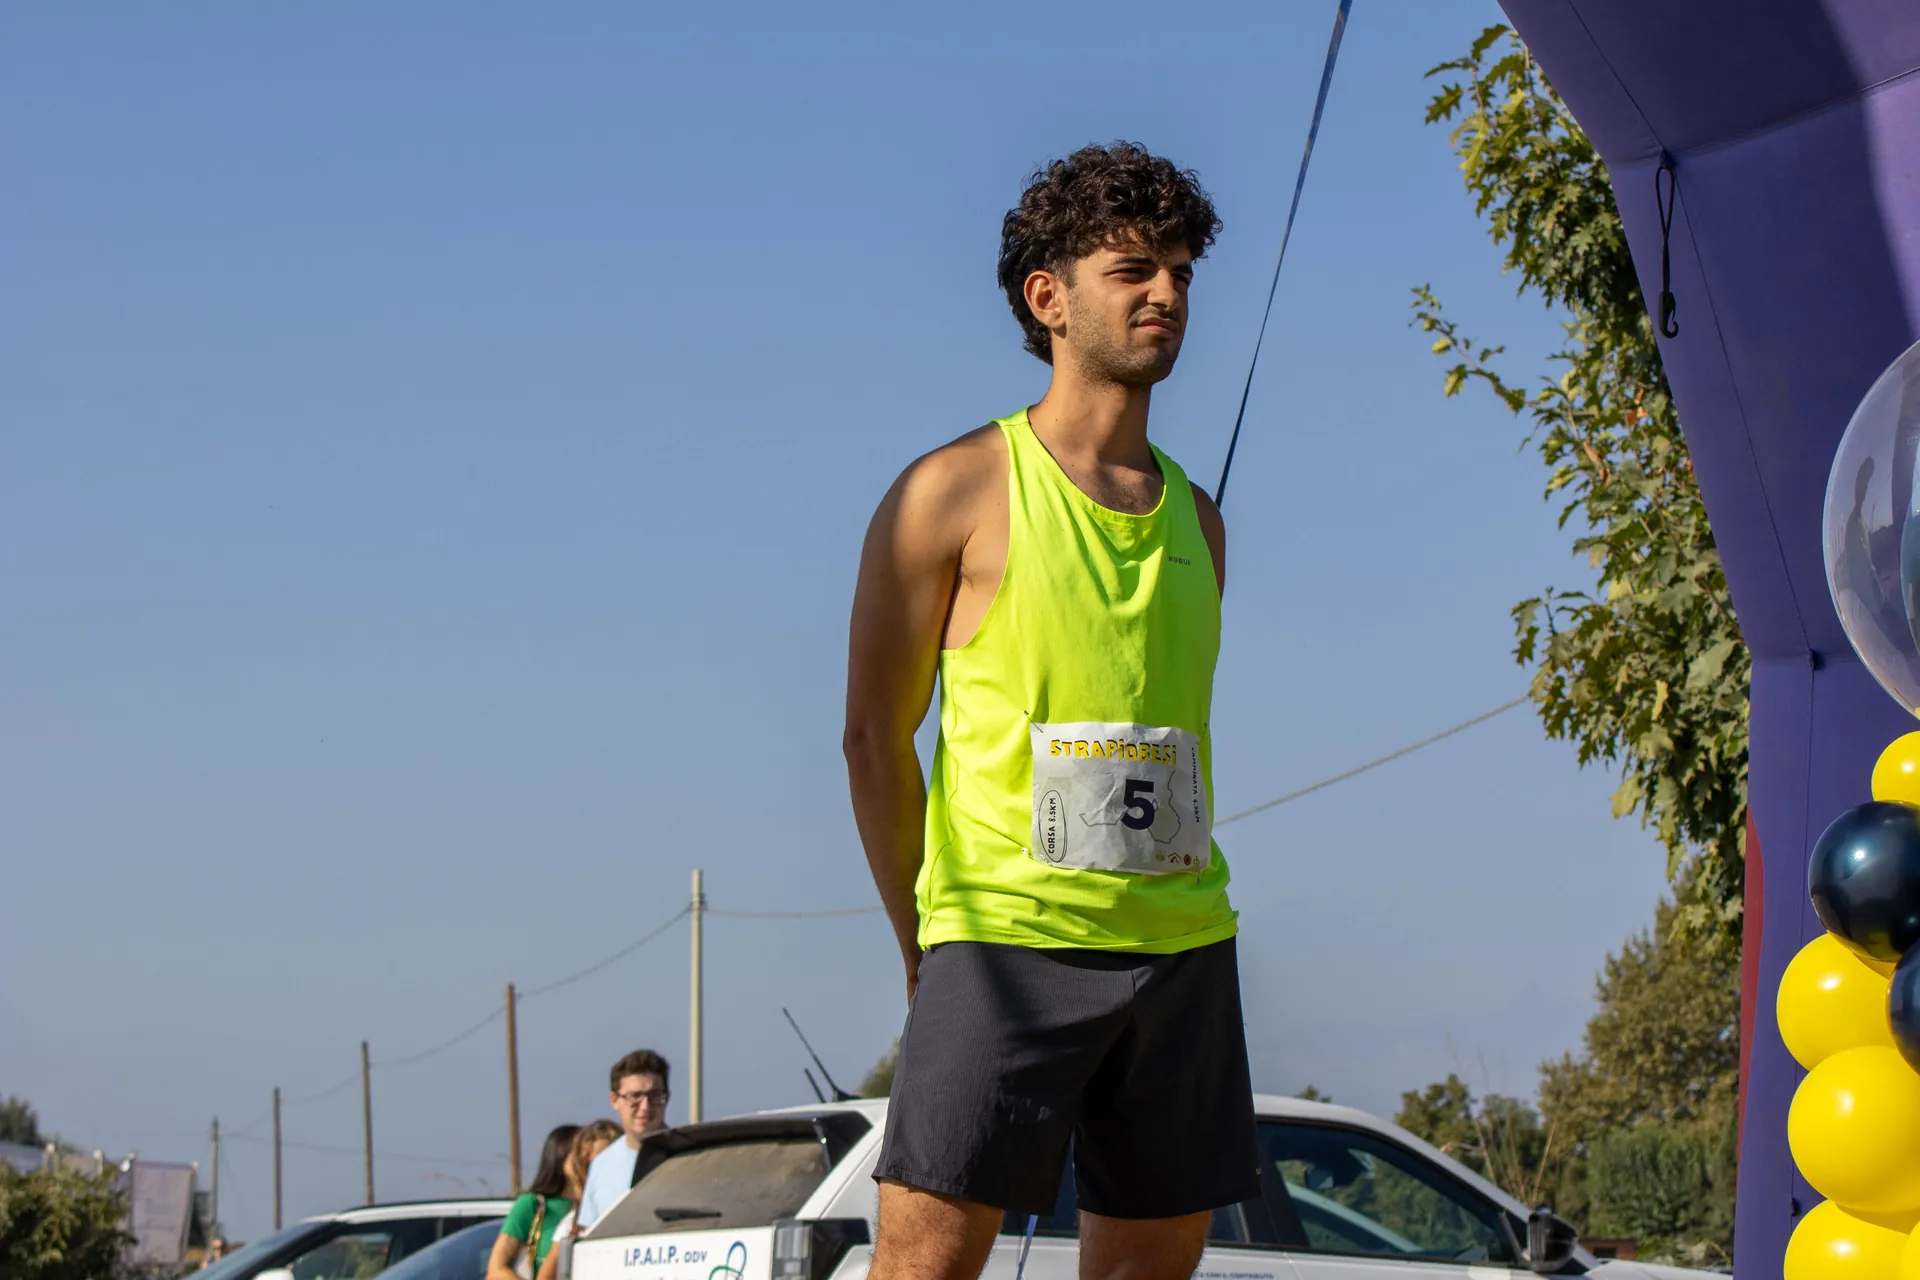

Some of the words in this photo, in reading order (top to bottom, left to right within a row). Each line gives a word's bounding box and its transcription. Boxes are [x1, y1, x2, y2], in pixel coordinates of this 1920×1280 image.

[1049, 797, 1057, 823] 8.5KM
[1121, 779, 1155, 831] 5
[1048, 824, 1057, 854] CORSA
[624, 1245, 680, 1267] I.P.A.I.P.
[683, 1250, 708, 1264] ODV
